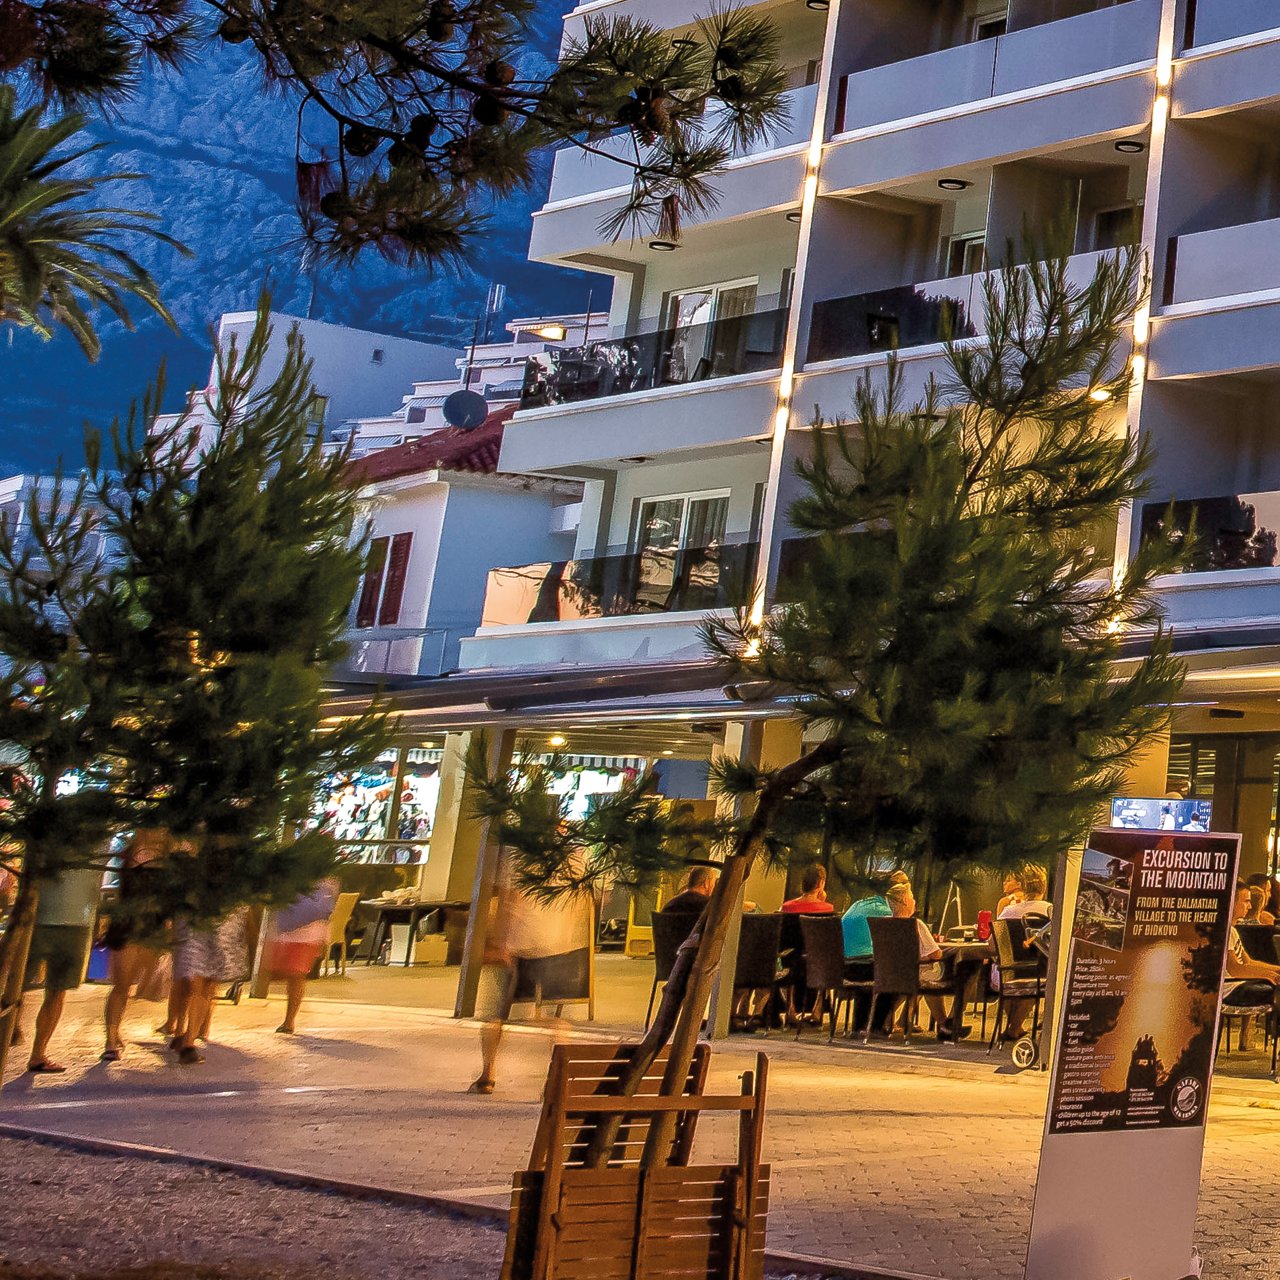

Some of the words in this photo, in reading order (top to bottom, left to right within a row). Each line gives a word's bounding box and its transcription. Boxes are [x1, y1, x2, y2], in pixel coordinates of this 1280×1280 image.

[1142, 850, 1212, 870] EXCURSION
[1214, 853, 1228, 870] TO
[1141, 870, 1162, 888] THE
[1165, 871, 1227, 890] MOUNTAIN
[1136, 897, 1159, 908] FROM
[1161, 897, 1175, 908] THE
[1177, 898, 1218, 909] DALMATIAN
[1135, 911, 1165, 922] VILLAGE
[1167, 911, 1176, 922] TO
[1179, 911, 1193, 923] THE
[1194, 912, 1217, 923] HEART
[1133, 925, 1143, 936] OF
[1145, 925, 1178, 936] BIOKOVO
